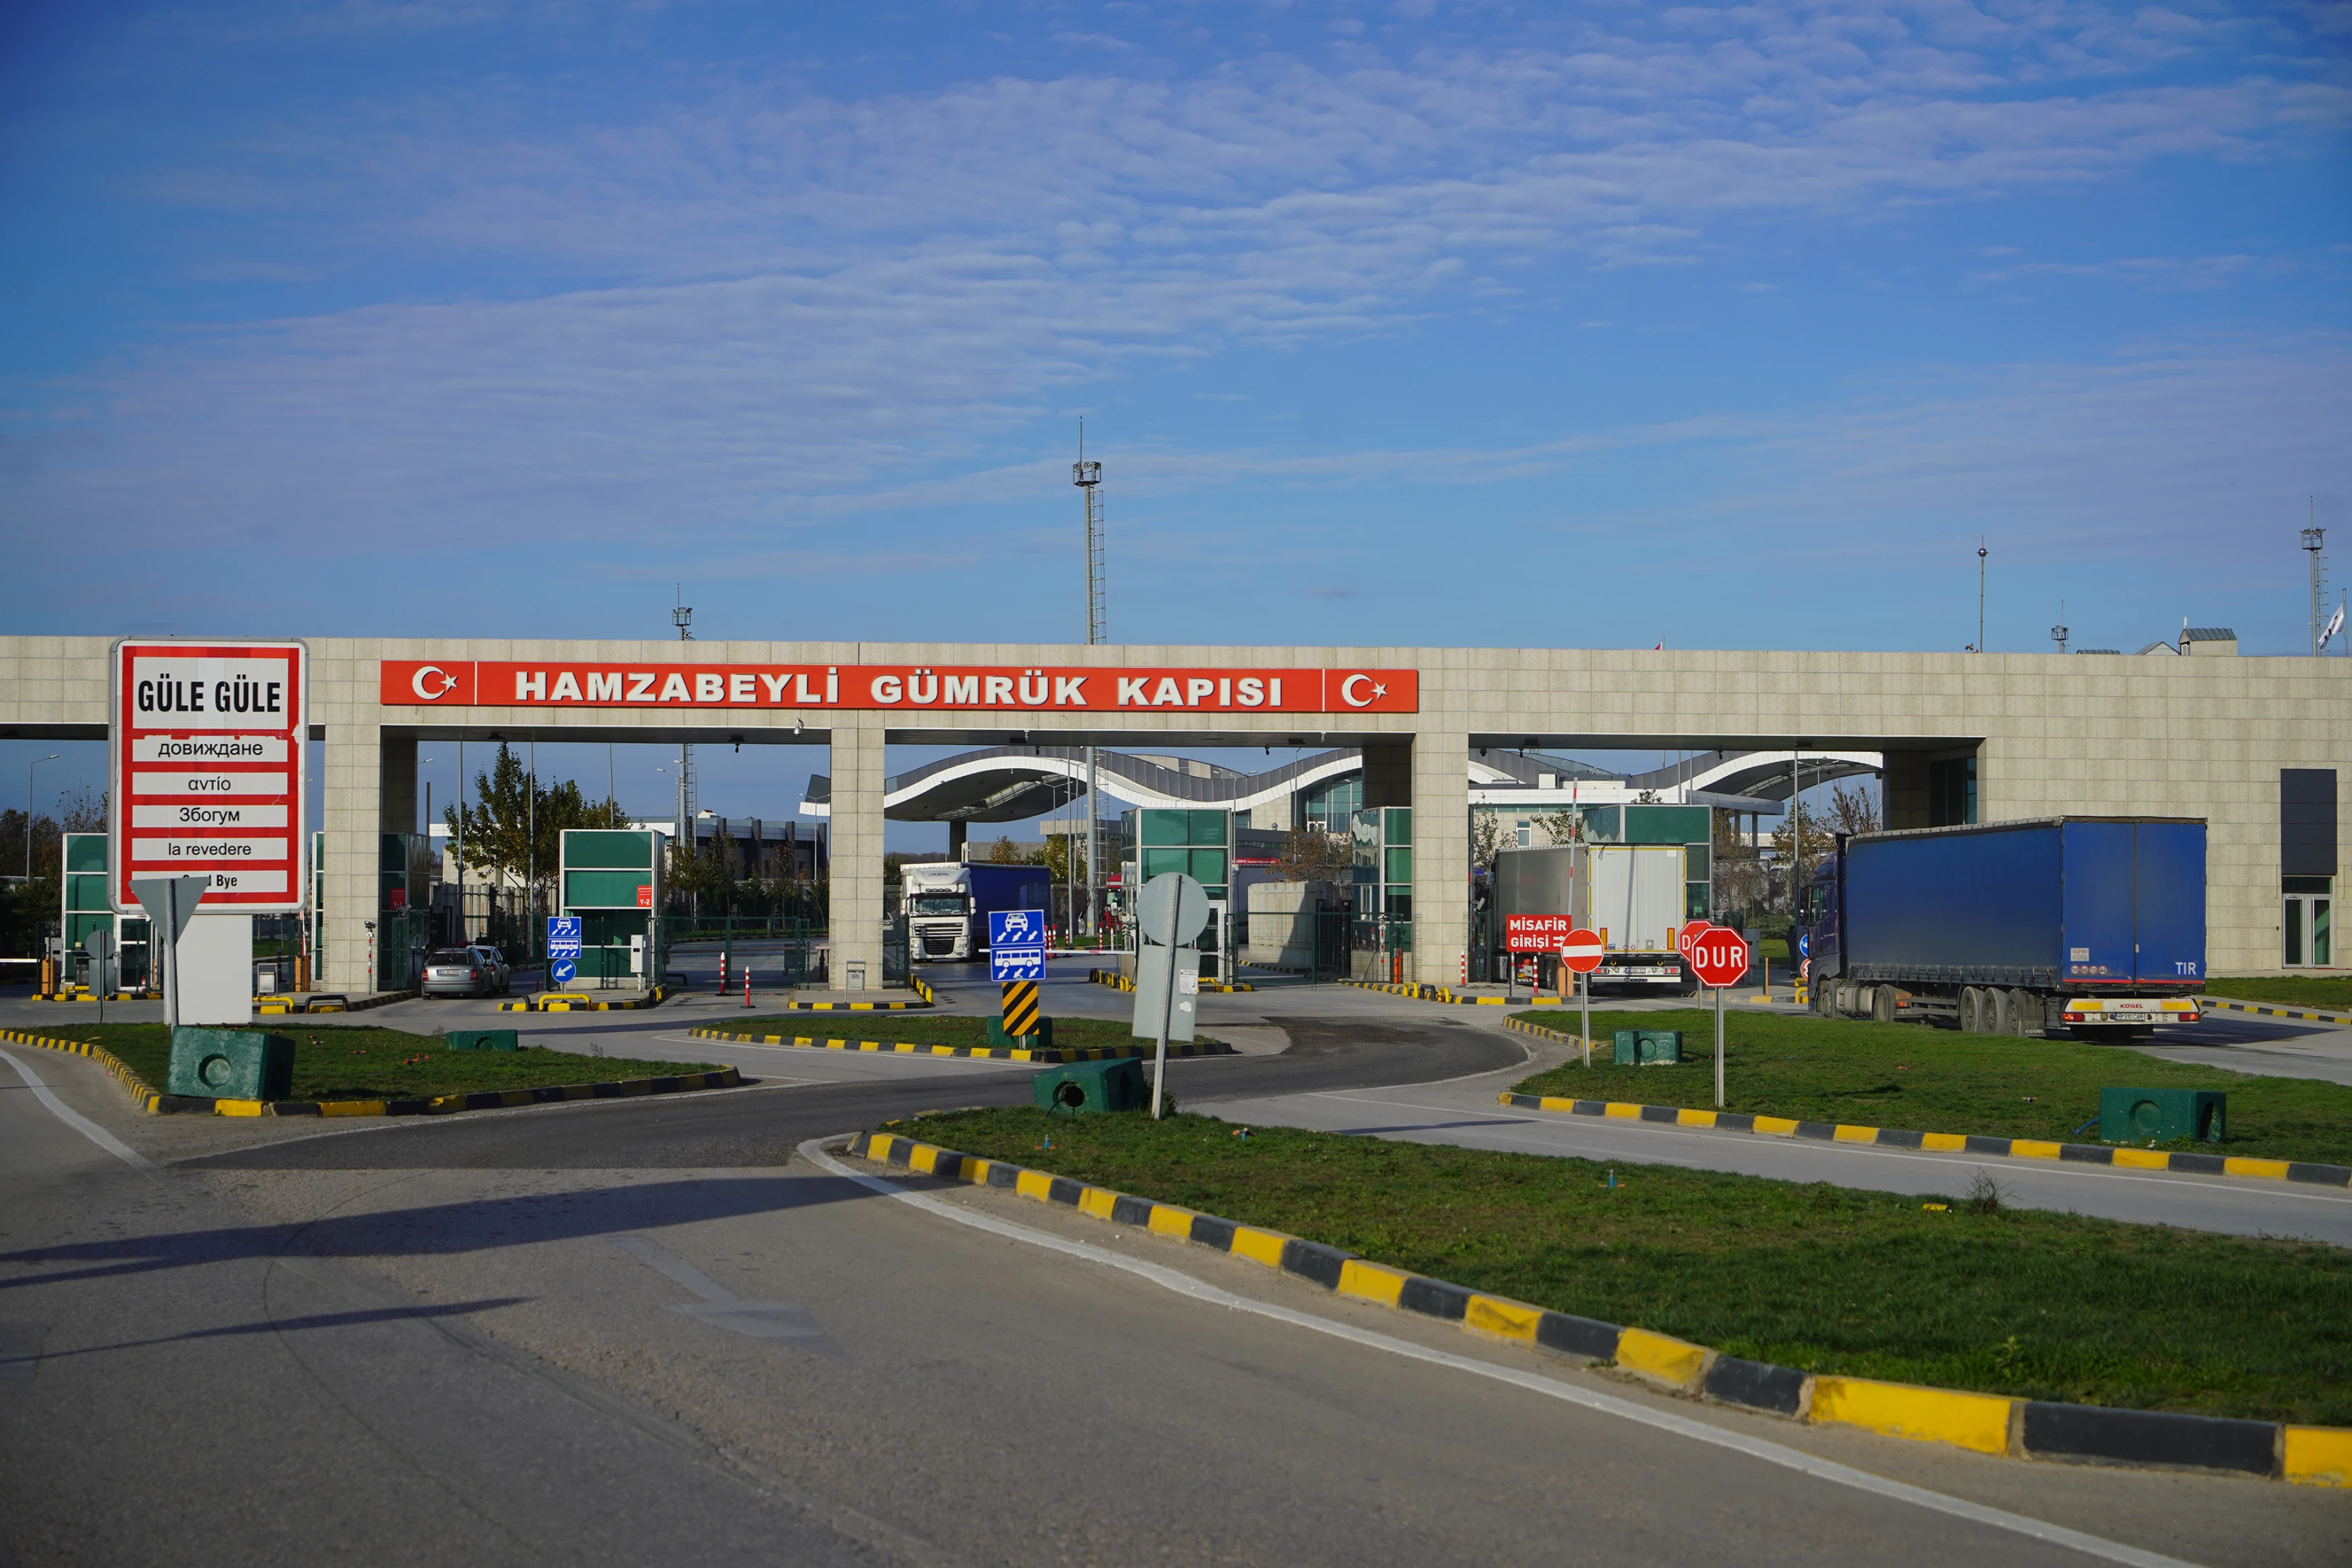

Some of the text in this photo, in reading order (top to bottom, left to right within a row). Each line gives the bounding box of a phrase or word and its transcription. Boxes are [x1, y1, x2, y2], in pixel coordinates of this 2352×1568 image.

[138, 673, 281, 713] GÜLE GÜLE
[515, 666, 1283, 707] HAMZABEYLİ GÜMRÜK KAPISI
[158, 743, 264, 758] довиждане
[179, 807, 240, 825] Збогум
[168, 843, 252, 856] la revedere
[216, 875, 238, 889] Bye
[1509, 917, 1567, 931] MİSAFİR
[1511, 934, 1549, 949] GİRİŞİ
[1696, 946, 1743, 968] DUR
[2175, 962, 2197, 976] TIR
